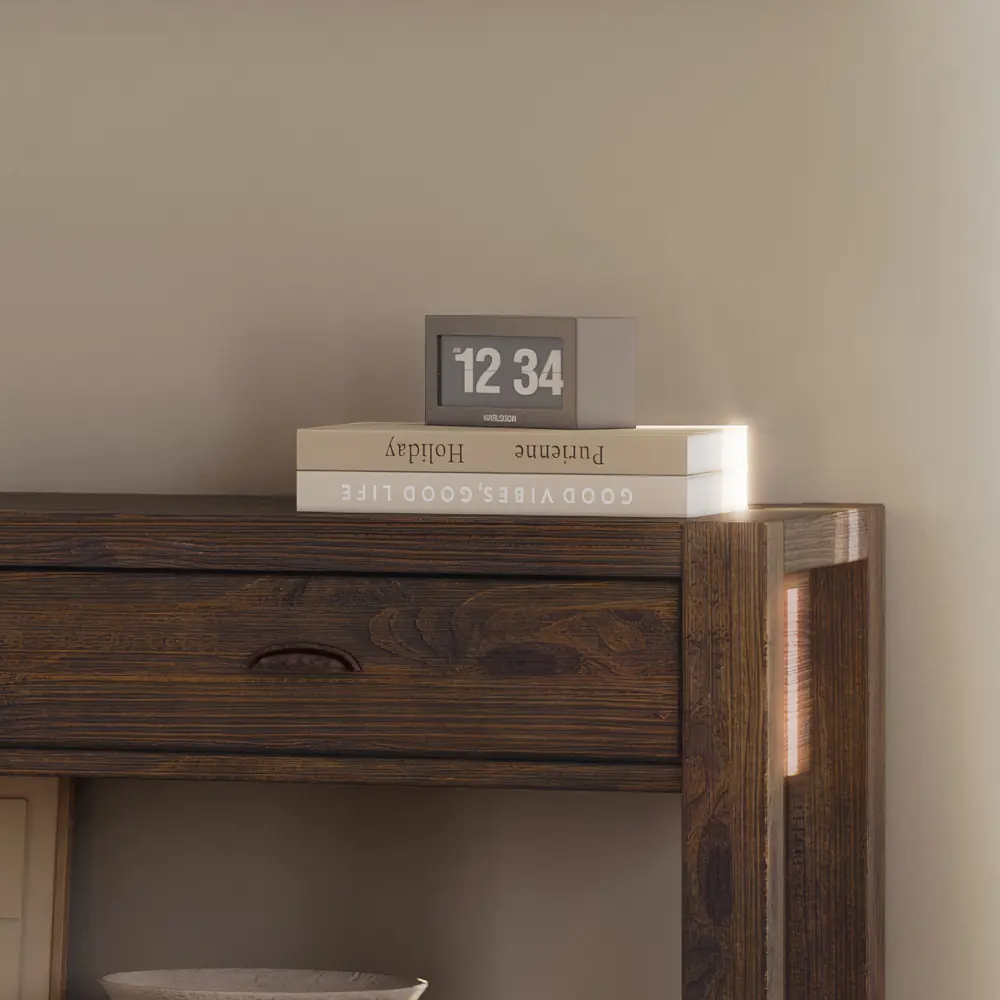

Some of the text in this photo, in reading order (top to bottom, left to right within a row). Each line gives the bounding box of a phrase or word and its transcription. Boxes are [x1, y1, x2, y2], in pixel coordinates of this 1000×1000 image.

[455, 347, 564, 396] 12 34
[385, 436, 605, 465] Purienne Holiday
[341, 484, 392, 502] LIFE
[563, 487, 633, 505] GOOD
